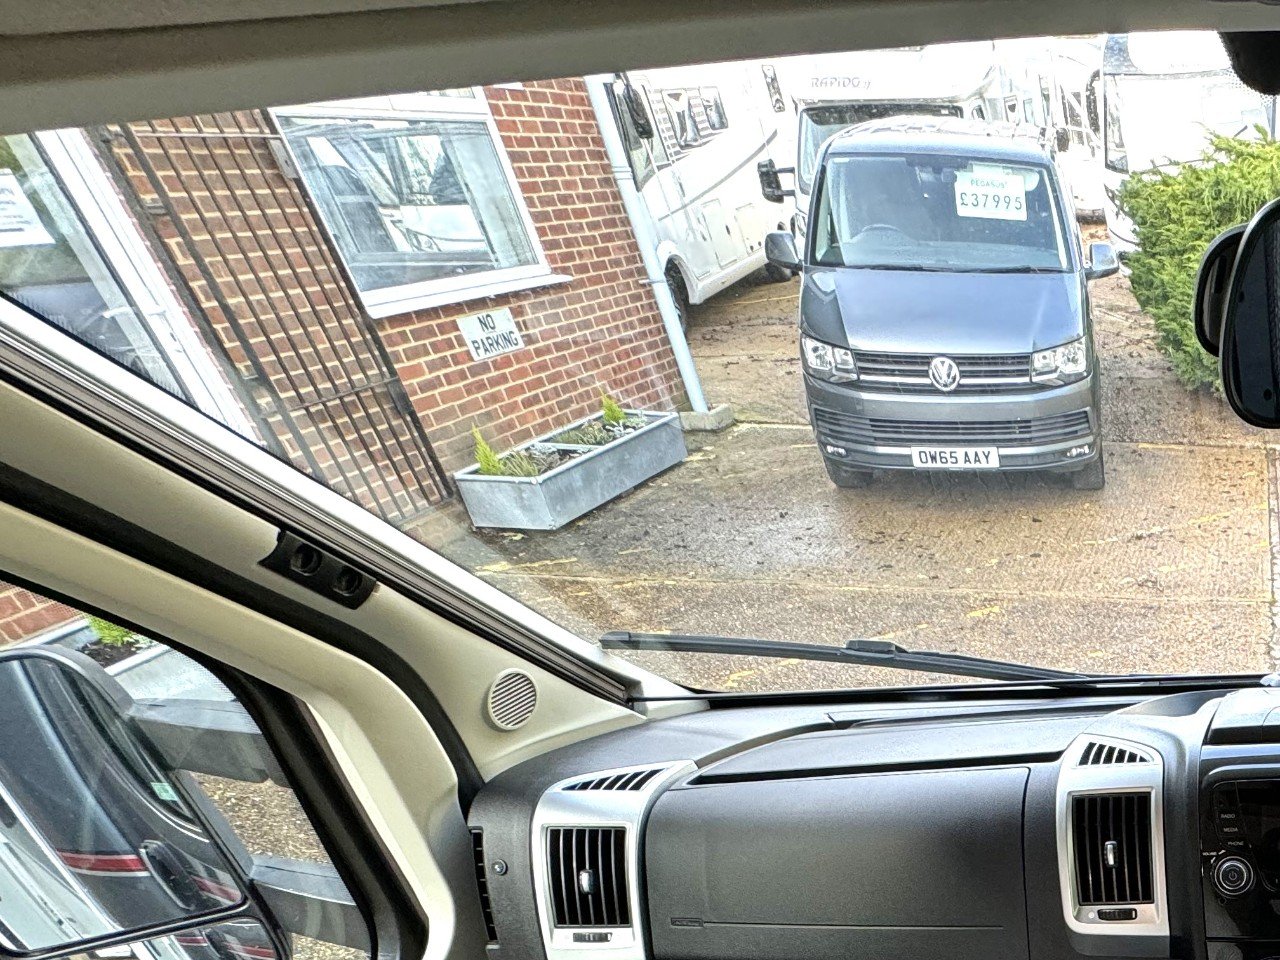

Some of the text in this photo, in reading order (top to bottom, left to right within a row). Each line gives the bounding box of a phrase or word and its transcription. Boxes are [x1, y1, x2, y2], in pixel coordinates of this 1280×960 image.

[960, 192, 1023, 210] £37995
[477, 313, 496, 332] NO
[471, 330, 519, 357] PARKING
[918, 450, 991, 464] OW65 AAY
